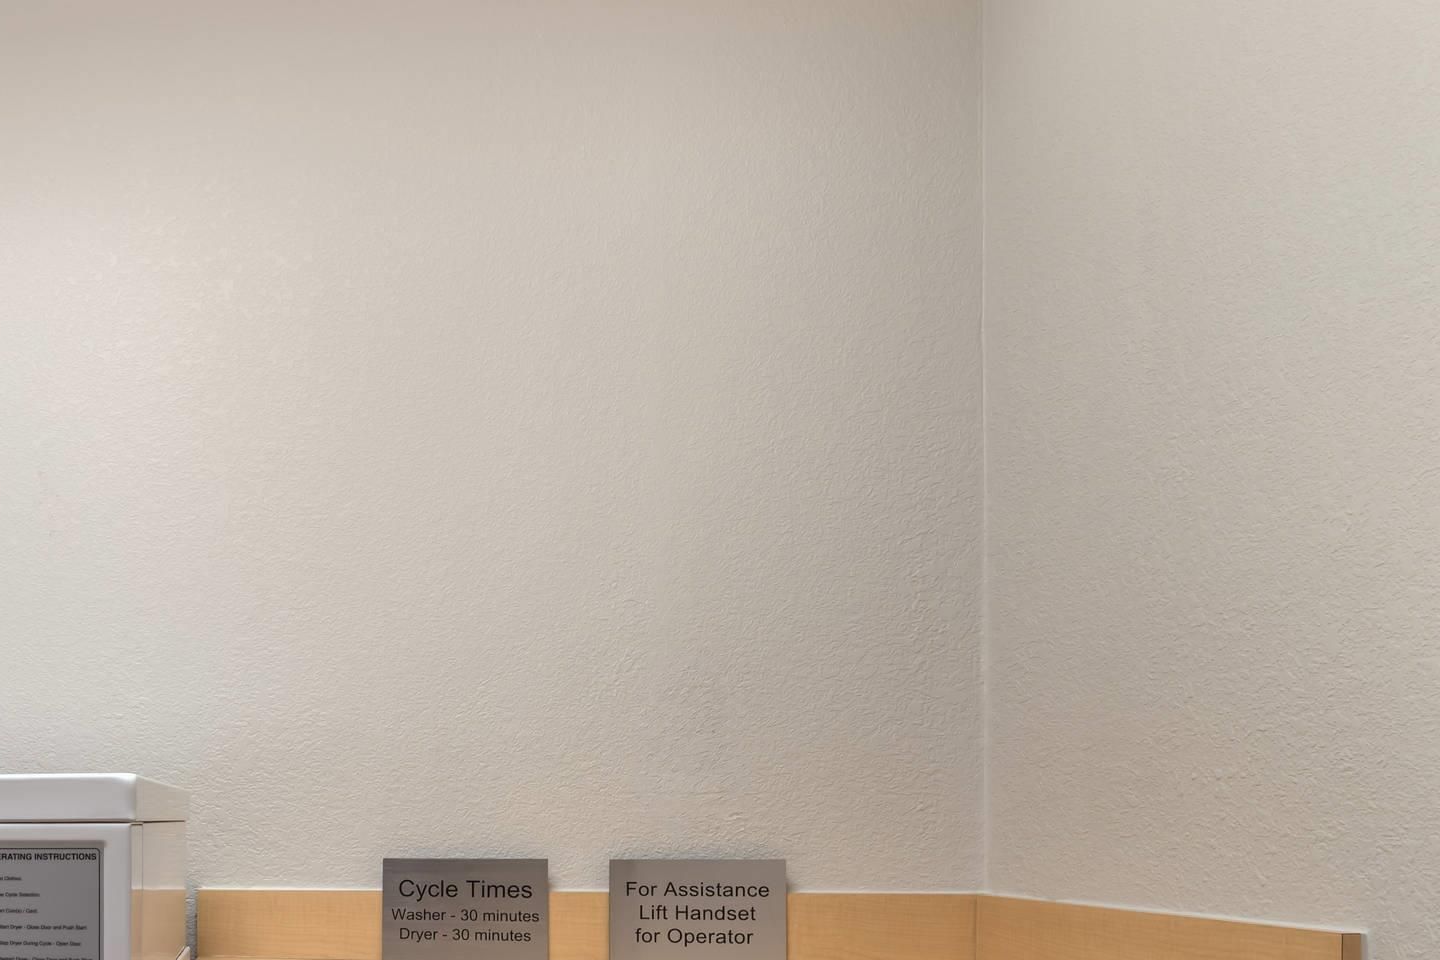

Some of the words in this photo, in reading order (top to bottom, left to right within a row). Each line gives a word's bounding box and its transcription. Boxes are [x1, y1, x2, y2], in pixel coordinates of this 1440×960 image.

[34, 853, 97, 861] INSTRUCTIONS
[399, 879, 458, 902] Cycle
[466, 880, 533, 899] Times
[626, 881, 658, 897] For
[664, 881, 770, 898] Assistance
[391, 908, 446, 921] Washer
[460, 909, 478, 922] 30
[482, 909, 540, 922] minutes
[639, 905, 668, 920] Lift
[675, 905, 757, 921] Handset
[400, 927, 438, 943] Dryer
[452, 928, 470, 941] 30
[474, 929, 532, 942] minutes
[635, 928, 661, 943] for
[667, 928, 754, 947] Operator
